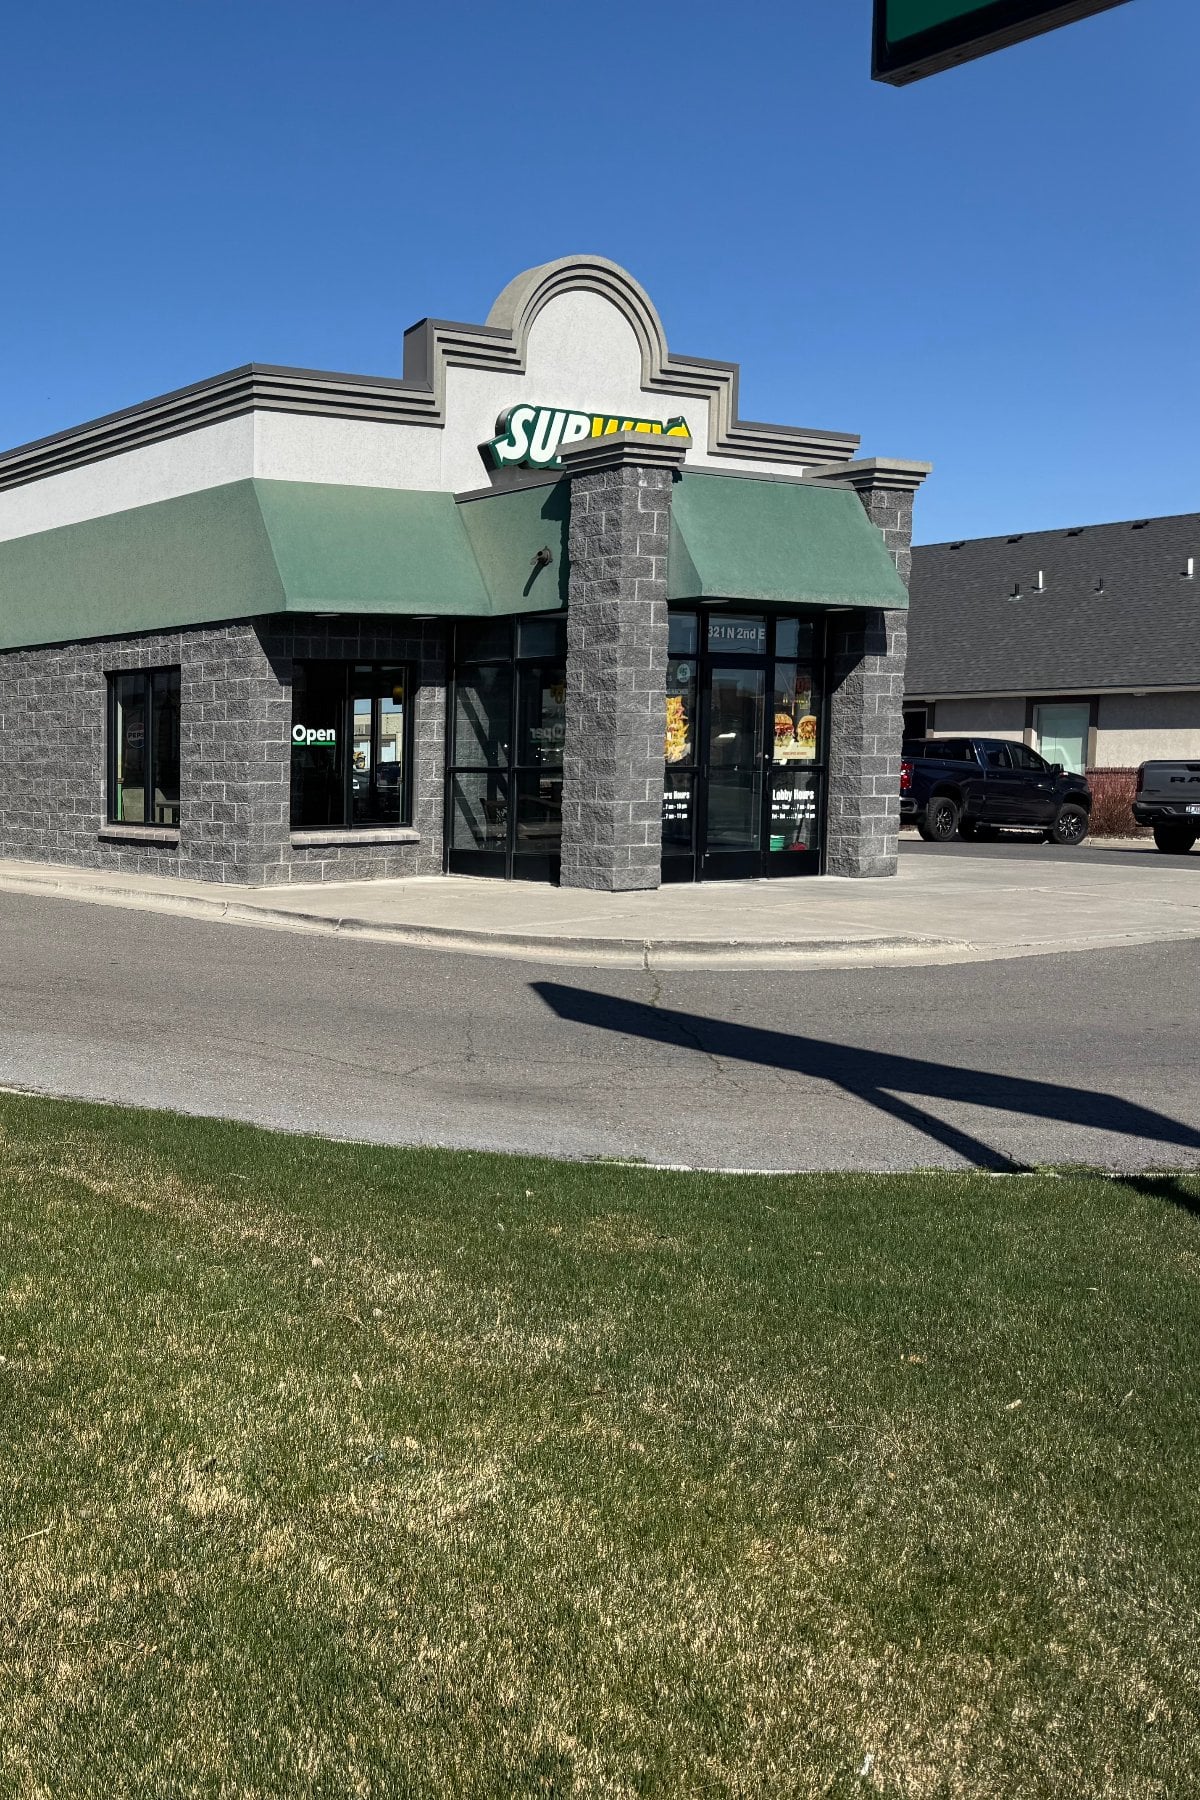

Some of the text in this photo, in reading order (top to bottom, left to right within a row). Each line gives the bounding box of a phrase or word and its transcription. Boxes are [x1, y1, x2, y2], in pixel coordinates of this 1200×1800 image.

[708, 625, 766, 640] 321 N 2nd E
[292, 724, 336, 746] Open
[772, 788, 815, 802] Lobby Hours
